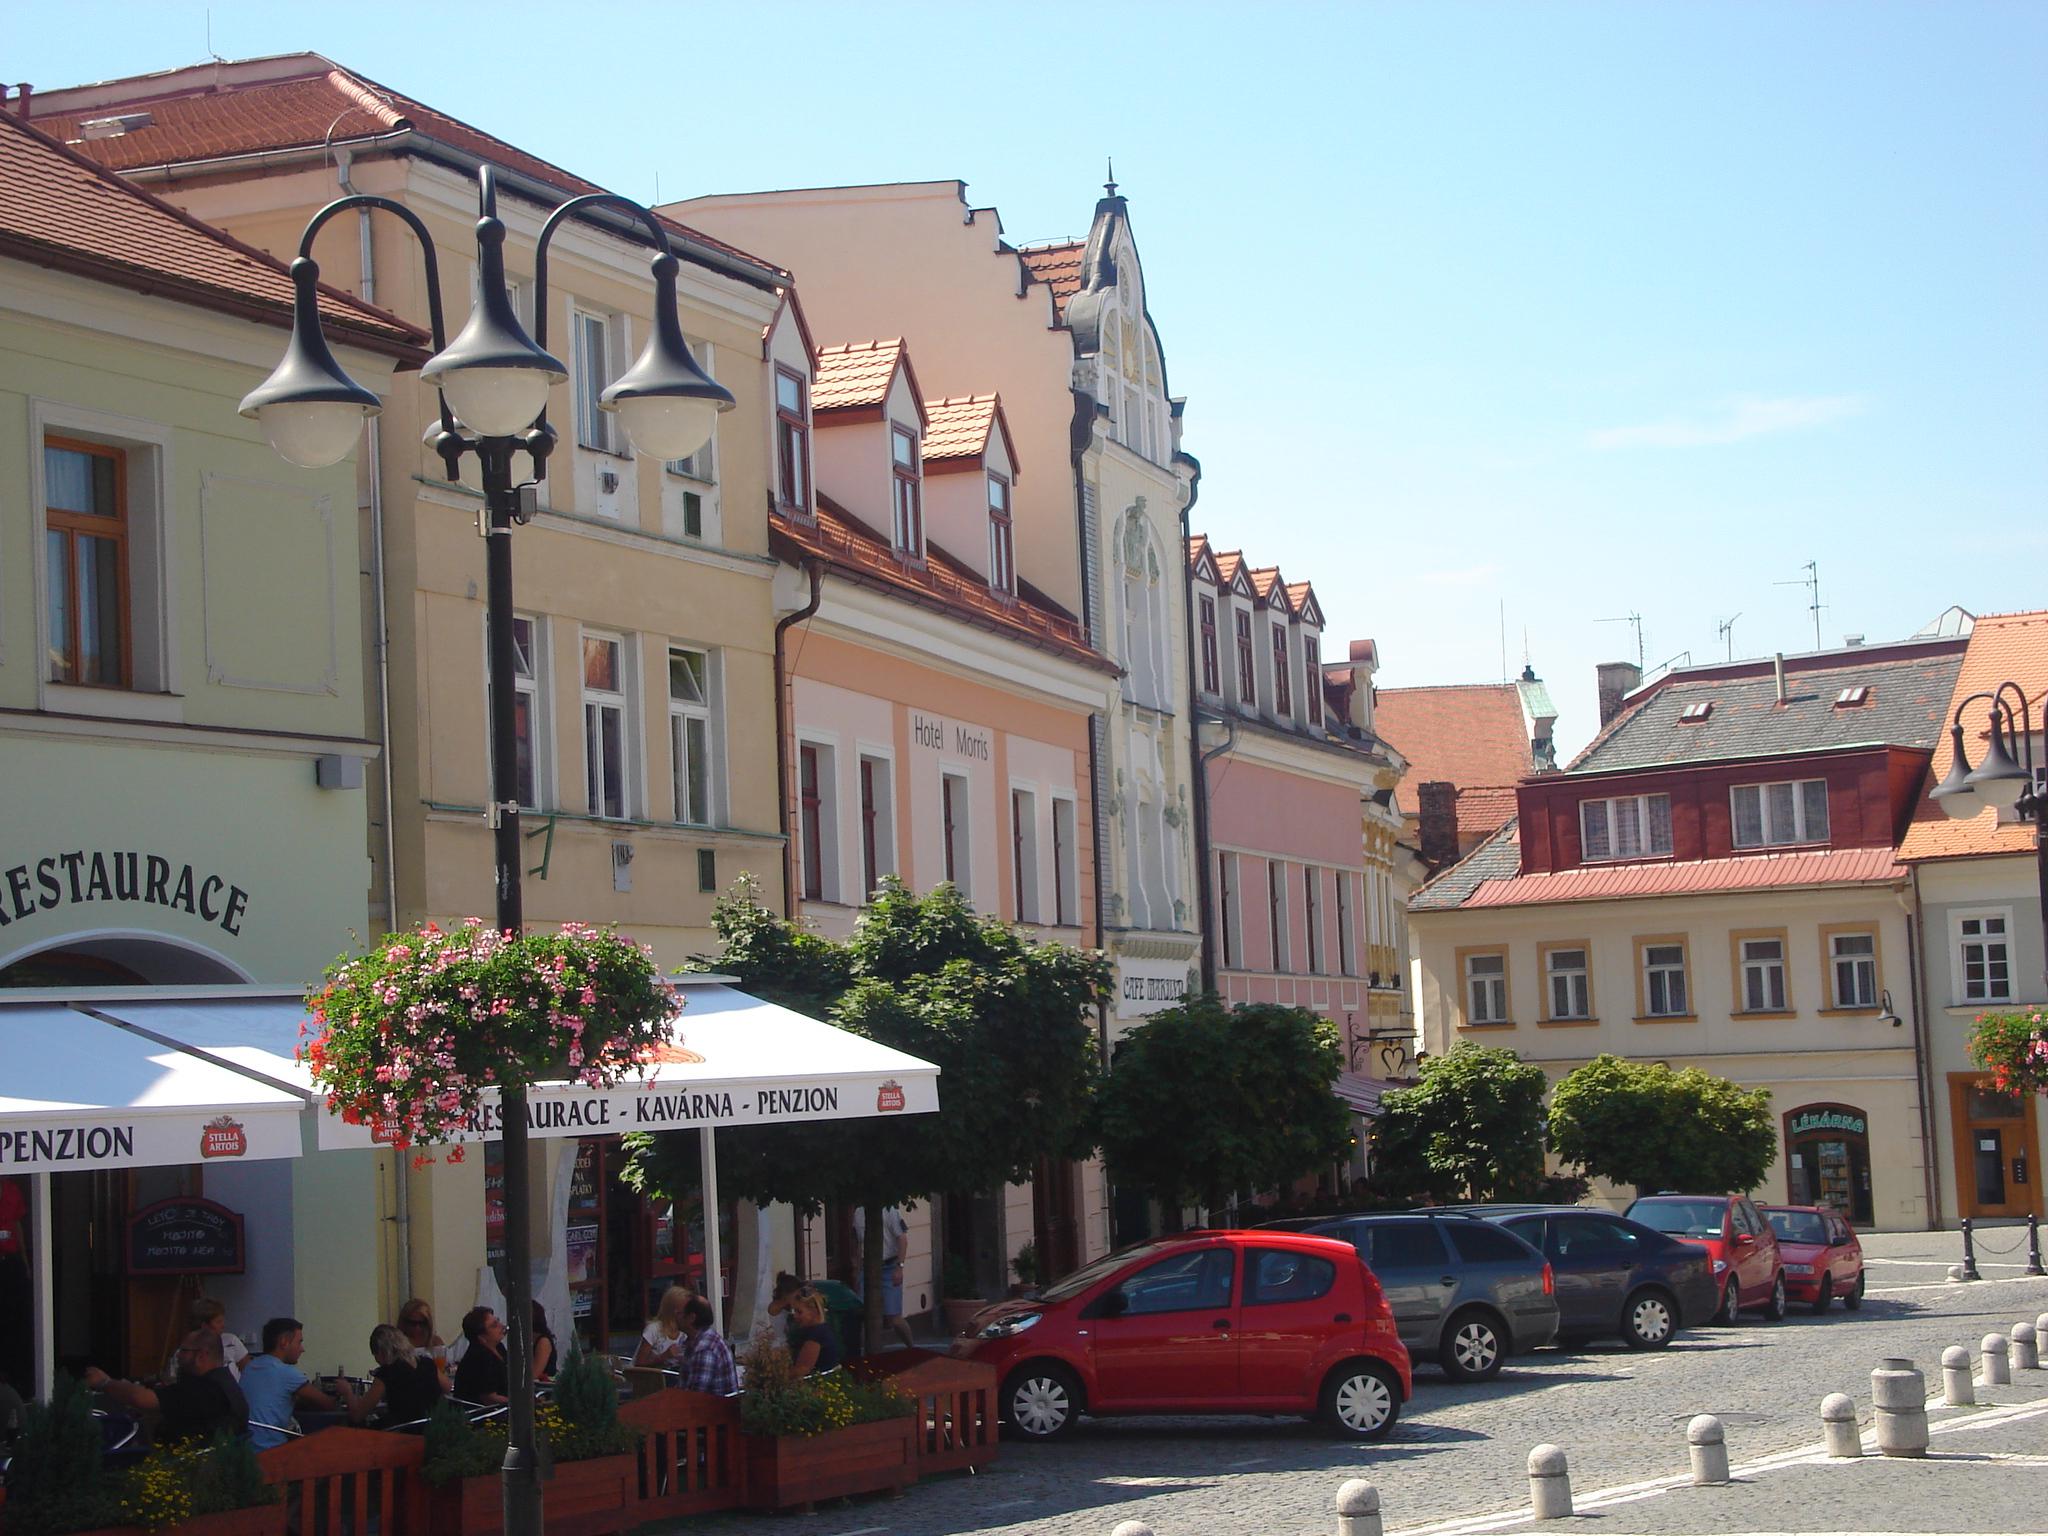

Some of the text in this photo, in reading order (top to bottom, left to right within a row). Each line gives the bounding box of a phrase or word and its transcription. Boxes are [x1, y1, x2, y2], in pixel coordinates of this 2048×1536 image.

[915, 715, 988, 761] Hotel Morris
[1123, 976, 1145, 1000] CAFE
[636, 1087, 735, 1123] KAVÁRNA
[757, 1087, 839, 1116] PENZION
[1791, 1110, 1865, 1134] LÉKÁRNA
[0, 1126, 134, 1163] PENZION
[208, 1132, 240, 1142] STELLA
[208, 1141, 240, 1151] ARTOIS
